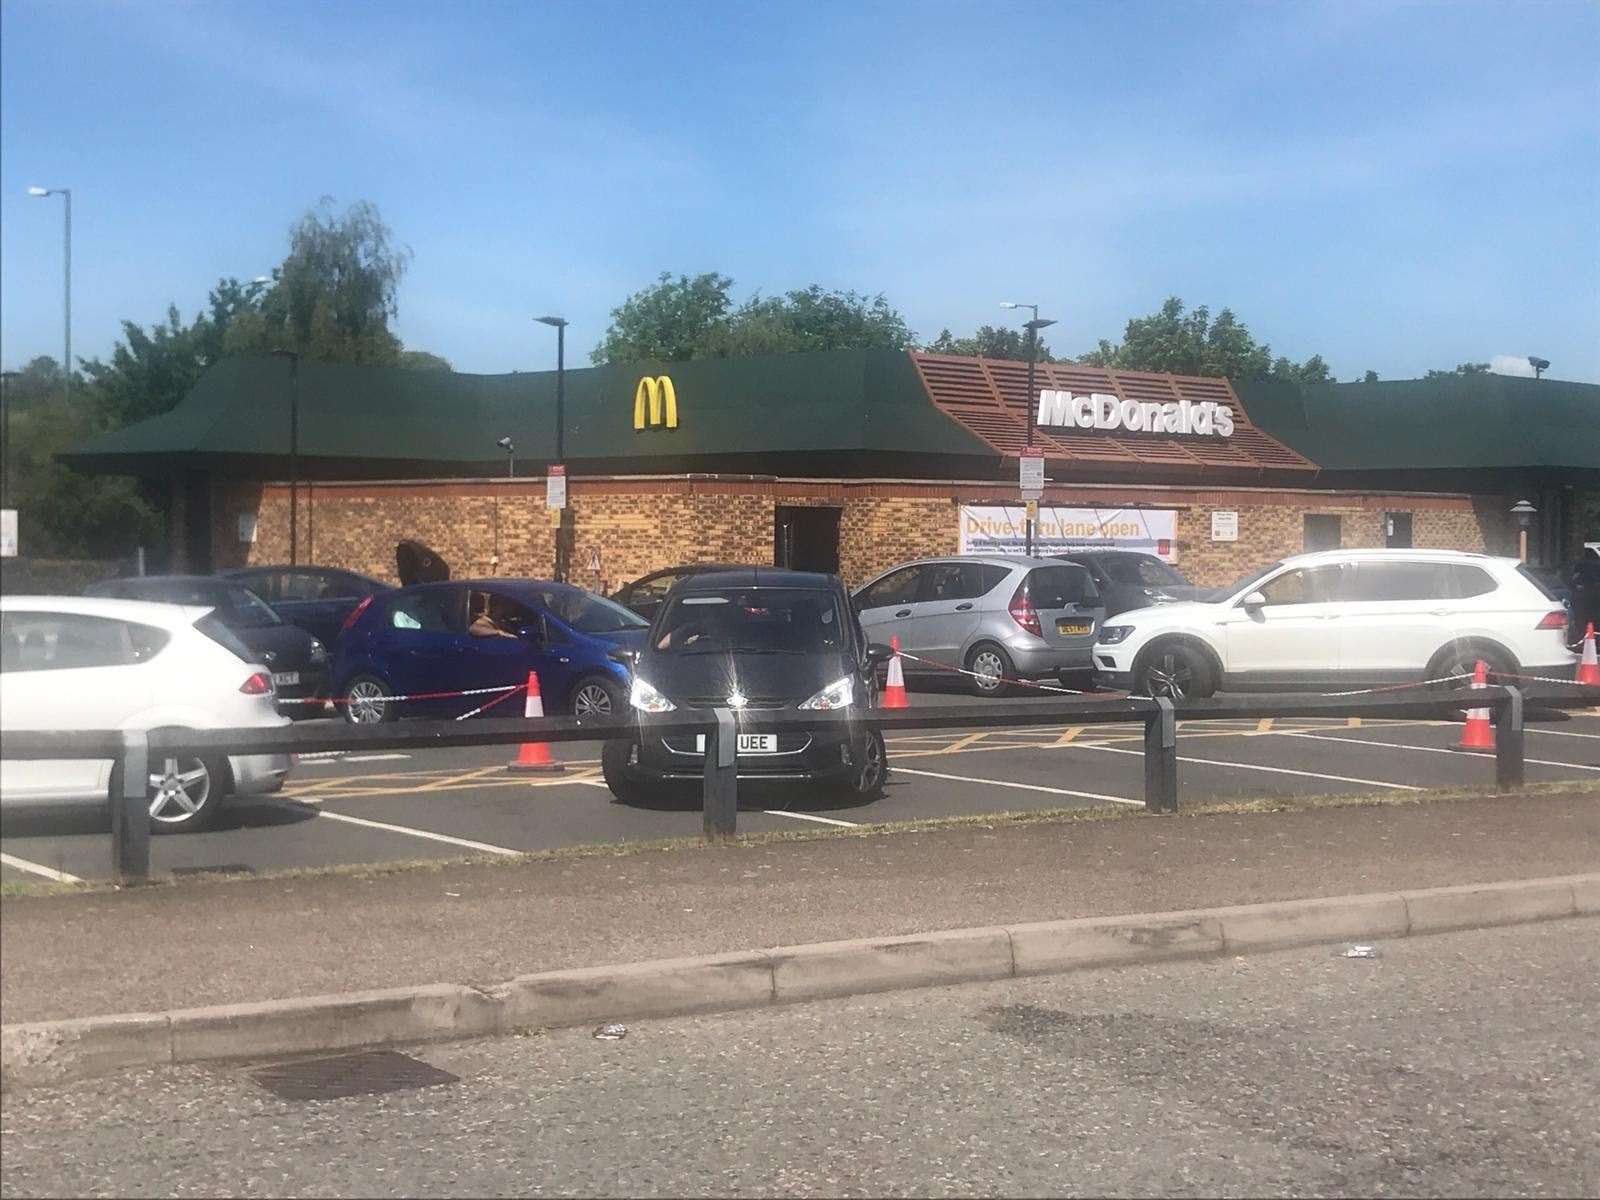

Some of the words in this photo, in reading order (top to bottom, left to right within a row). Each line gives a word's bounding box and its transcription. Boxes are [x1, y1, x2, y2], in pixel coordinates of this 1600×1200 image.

[1037, 389, 1234, 437] McDonald's
[1061, 518, 1095, 536] lane
[1099, 522, 1140, 540] open
[740, 735, 768, 750] UEE
